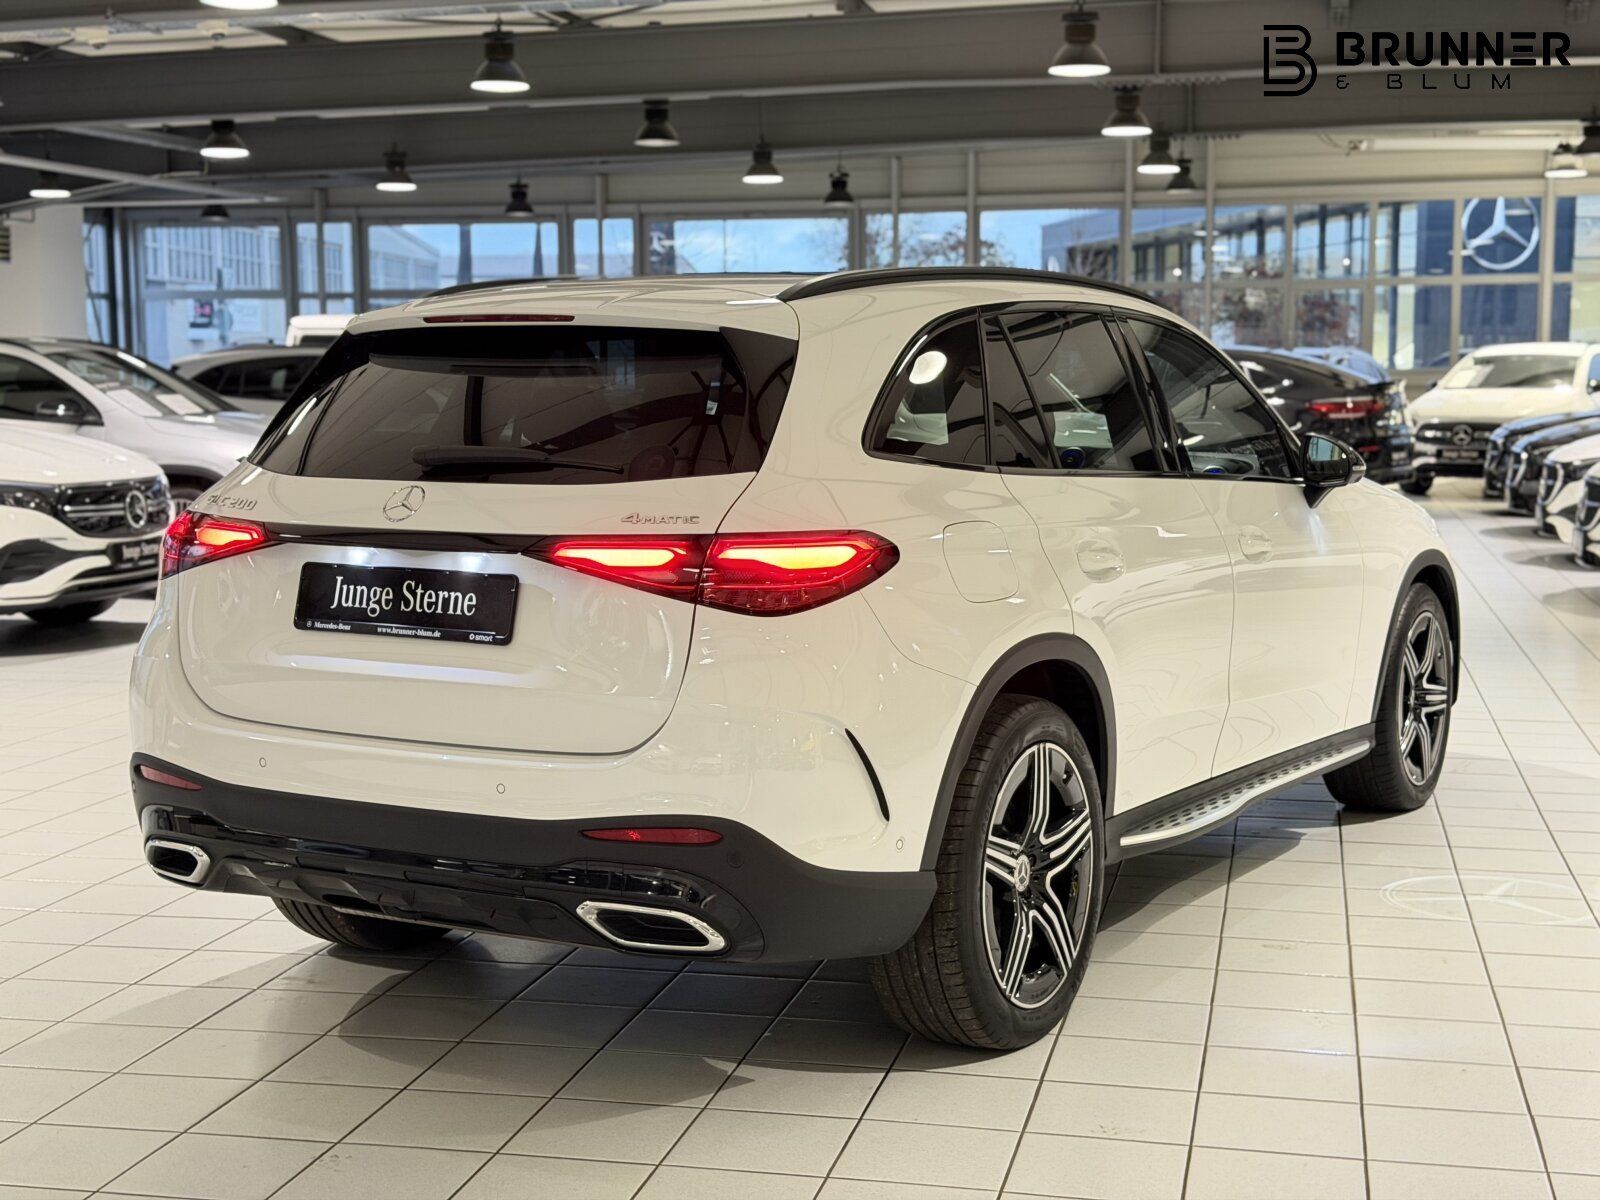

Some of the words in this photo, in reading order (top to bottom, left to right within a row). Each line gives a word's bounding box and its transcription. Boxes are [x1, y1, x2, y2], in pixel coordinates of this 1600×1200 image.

[228, 497, 258, 511] 200
[621, 512, 700, 525] 4MATIC
[330, 575, 393, 617] Junge
[401, 580, 477, 616] Sterne
[314, 621, 351, 631] Mercedes-Benz
[377, 626, 442, 638] www.brunner-blum.de
[475, 634, 493, 642] smart
